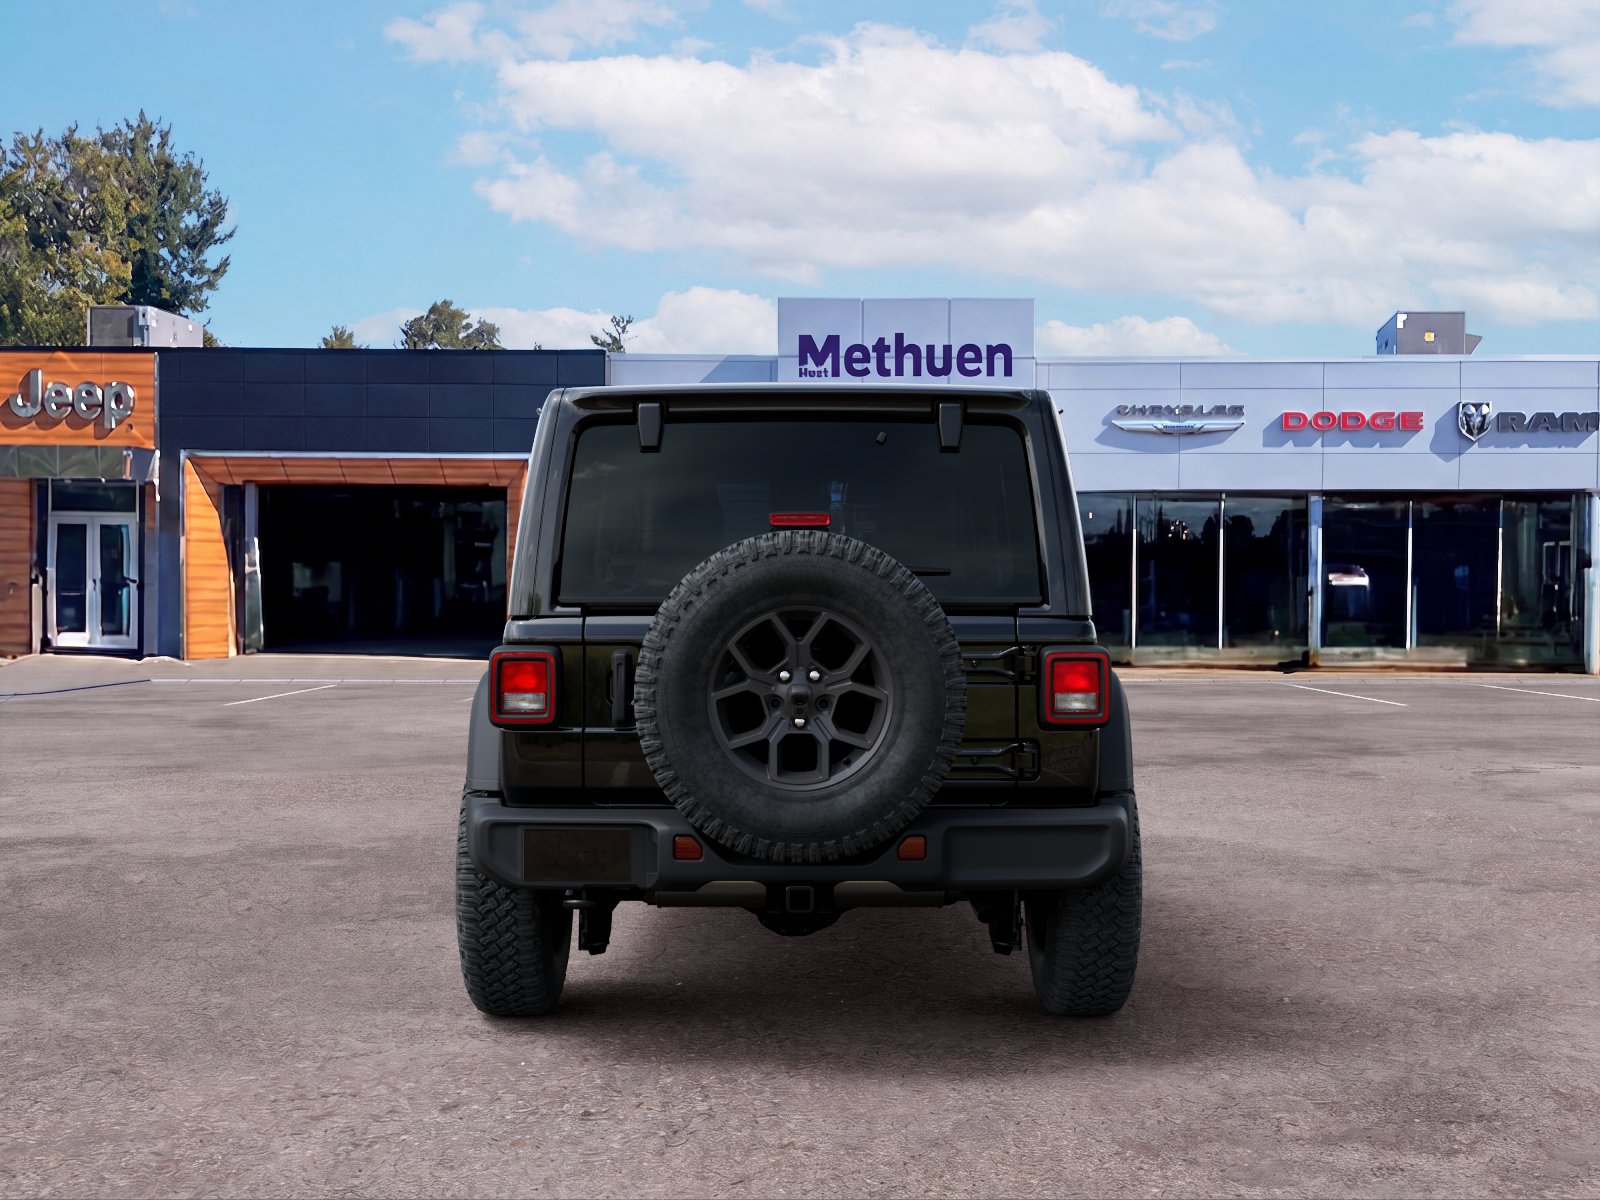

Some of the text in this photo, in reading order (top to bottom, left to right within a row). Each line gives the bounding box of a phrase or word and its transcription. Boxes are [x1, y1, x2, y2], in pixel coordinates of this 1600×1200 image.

[798, 332, 1013, 377] Methuen
[8, 367, 136, 430] Jeep
[1282, 411, 1424, 432] DODGE
[1497, 411, 1600, 433] RAM
